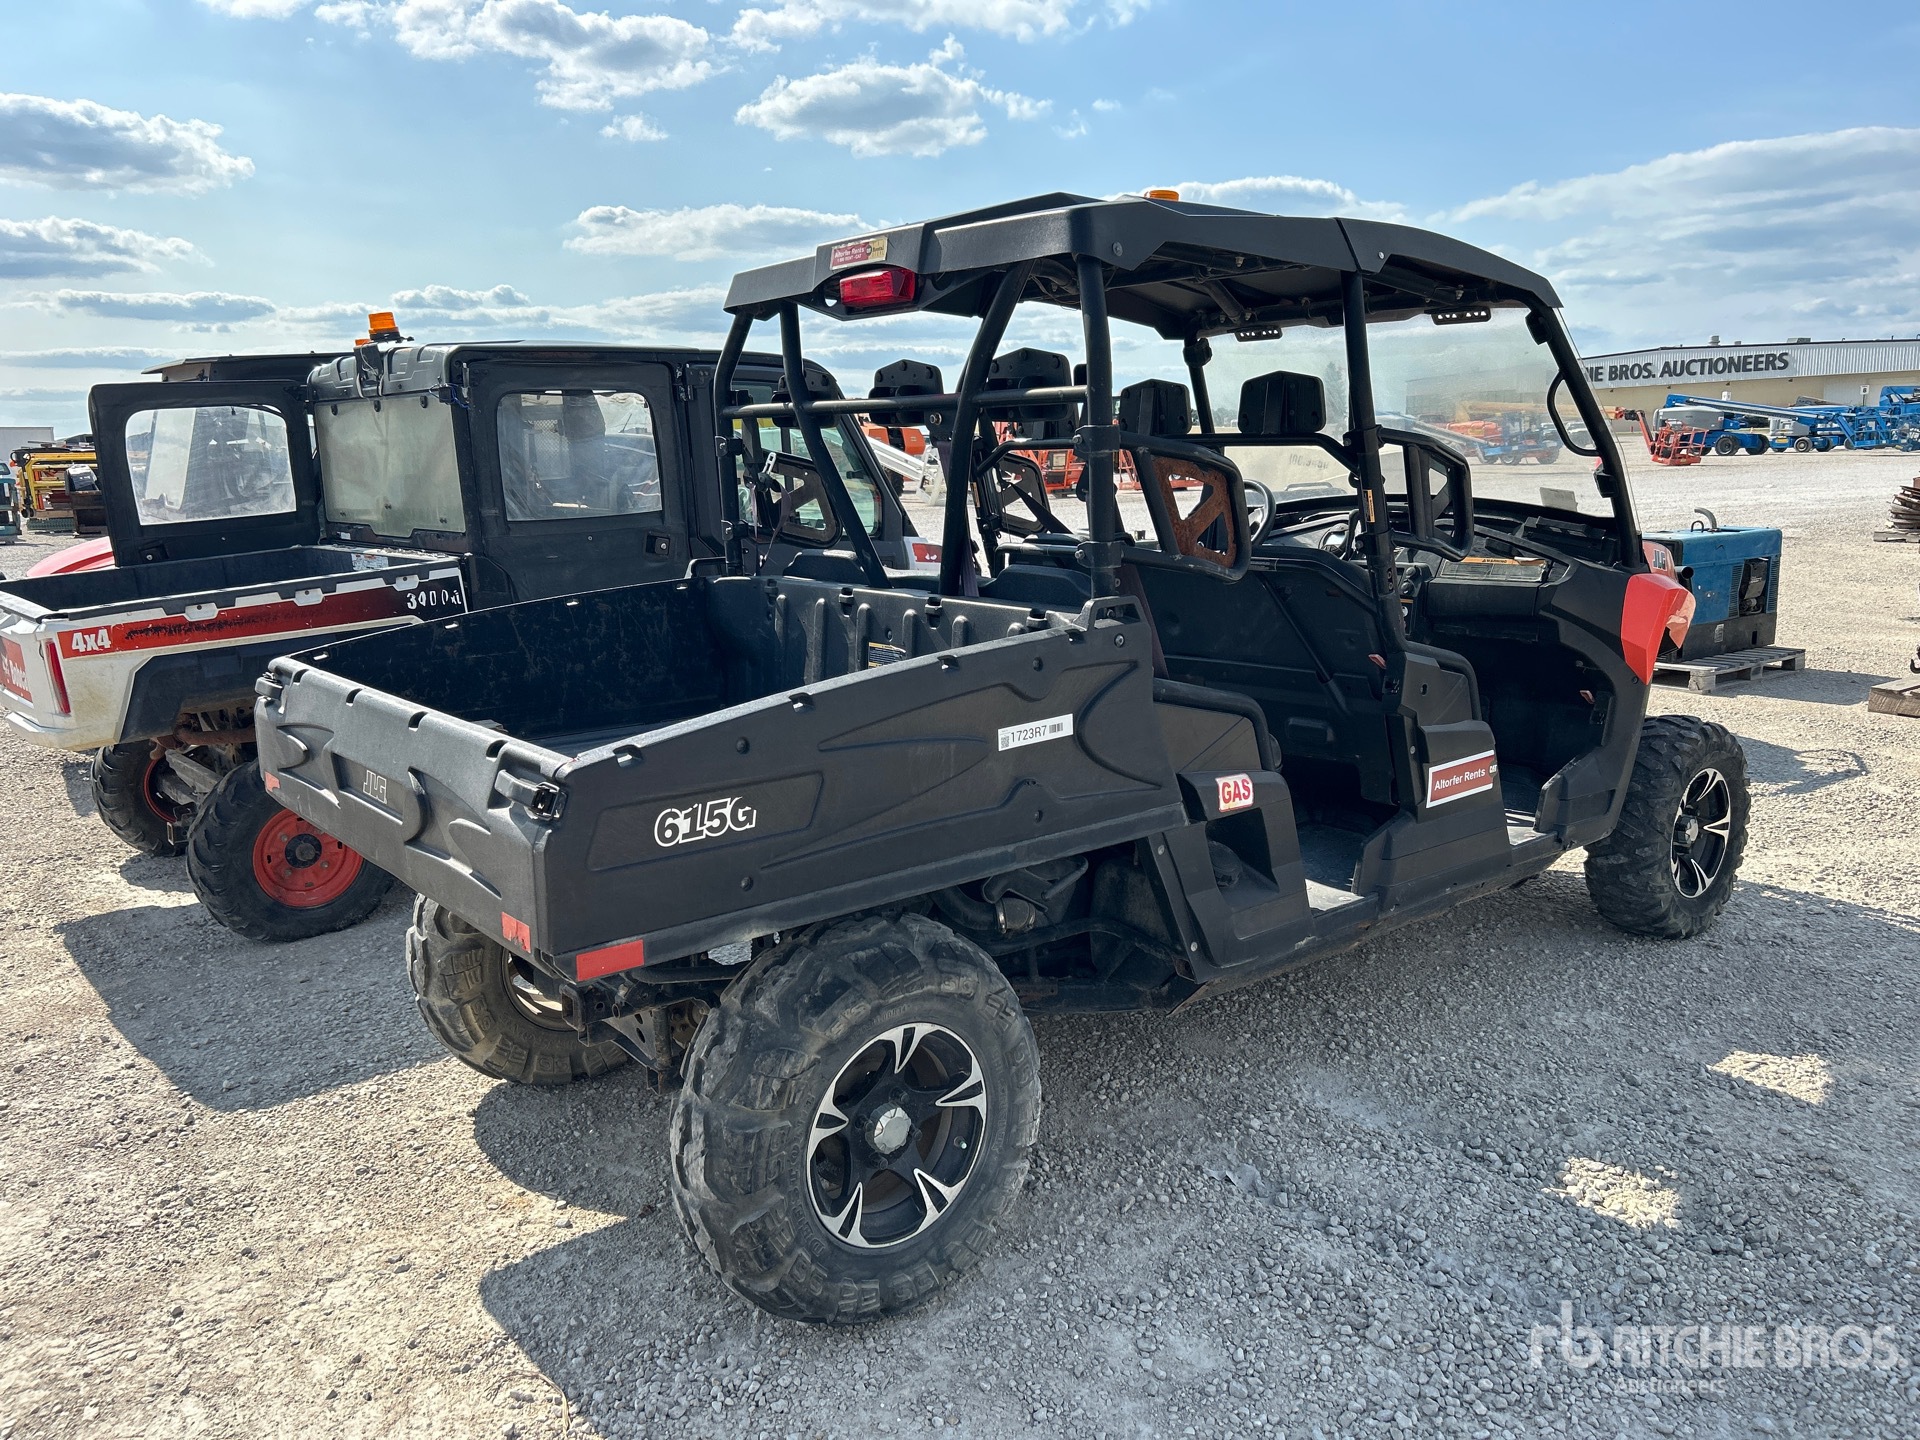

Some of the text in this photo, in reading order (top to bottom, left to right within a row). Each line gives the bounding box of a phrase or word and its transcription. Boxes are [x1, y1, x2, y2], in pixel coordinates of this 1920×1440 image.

[1585, 352, 1789, 382] IE BROS. AUCTIONEERS
[1653, 549, 1667, 571] JLG
[71, 628, 112, 653] 4x4
[1011, 724, 1047, 743] 1723R7
[362, 769, 388, 805] JLG
[1221, 778, 1251, 804] GAS
[1434, 768, 1486, 791] Altorfer Rents
[653, 795, 758, 848] 615G
